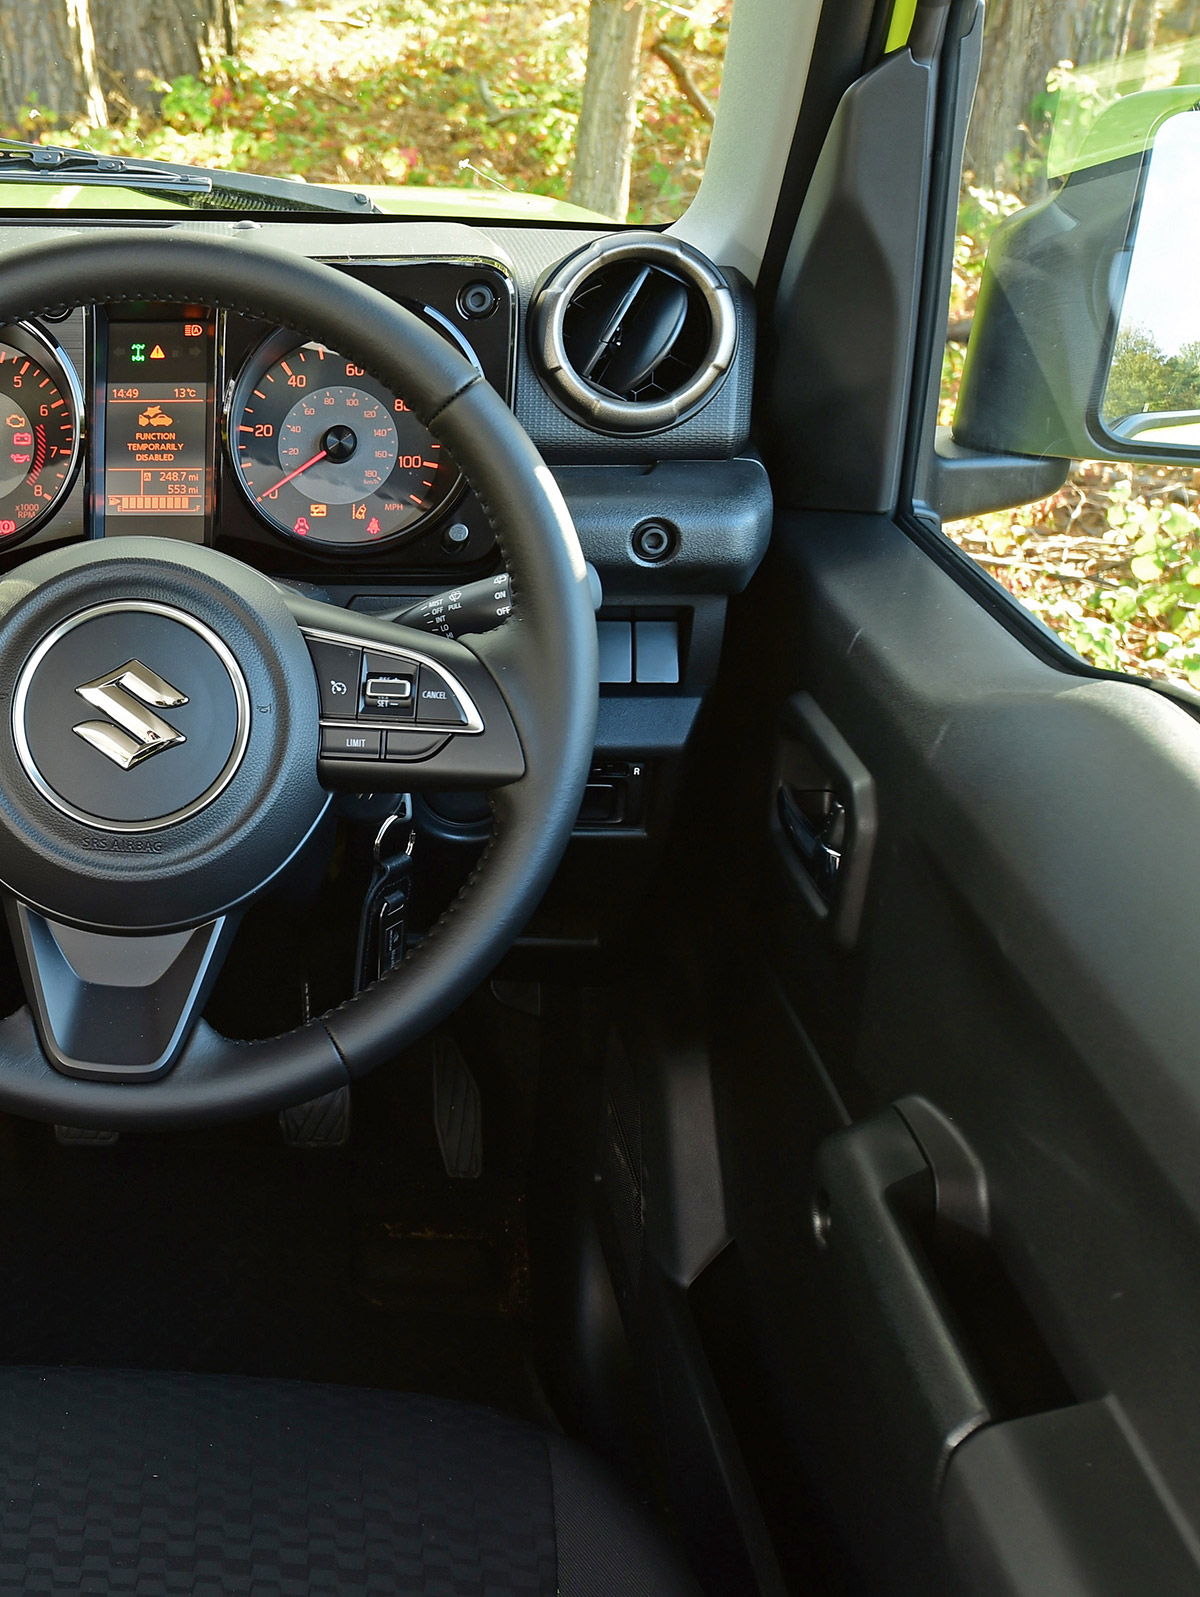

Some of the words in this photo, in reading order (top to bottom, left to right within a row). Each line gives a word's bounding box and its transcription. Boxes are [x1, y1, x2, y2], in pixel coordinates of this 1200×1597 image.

[13, 376, 22, 388] 5
[287, 374, 307, 388] 40
[112, 388, 139, 398] 14:49
[323, 397, 335, 405] 80
[346, 398, 359, 406] 100
[39, 405, 49, 417] 6
[304, 408, 315, 416] 60
[363, 410, 377, 418] 120
[255, 424, 273, 437] 20
[290, 425, 301, 433] 40
[373, 429, 387, 437] 140
[135, 432, 176, 441] FUNCTION
[127, 443, 184, 451] TEMPORARILY
[288, 447, 299, 455] 20
[50, 446, 58, 458] 7
[374, 450, 388, 458] 160
[135, 454, 175, 462] DISABLED
[398, 456, 422, 468] 100
[159, 472, 187, 481] 248.7
[188, 473, 199, 481] mi
[33, 485, 43, 497] 8
[167, 484, 187, 494] 553
[188, 485, 199, 494] mi
[15, 504, 40, 512] x1000
[384, 503, 403, 511] MPH
[17, 510, 36, 519] RPM
[494, 591, 506, 600] ON
[428, 599, 443, 608] MIST
[447, 602, 462, 611] PULL
[431, 606, 444, 616] OFF
[496, 606, 511, 616] OFF
[435, 614, 446, 624] INT
[440, 623, 450, 632] LO
[422, 691, 447, 700] CANCEL
[377, 699, 389, 708] SET
[346, 738, 366, 747] LIMIT
[633, 767, 640, 775] R
[82, 837, 107, 850] SRS
[112, 839, 163, 853] AIRBAG
